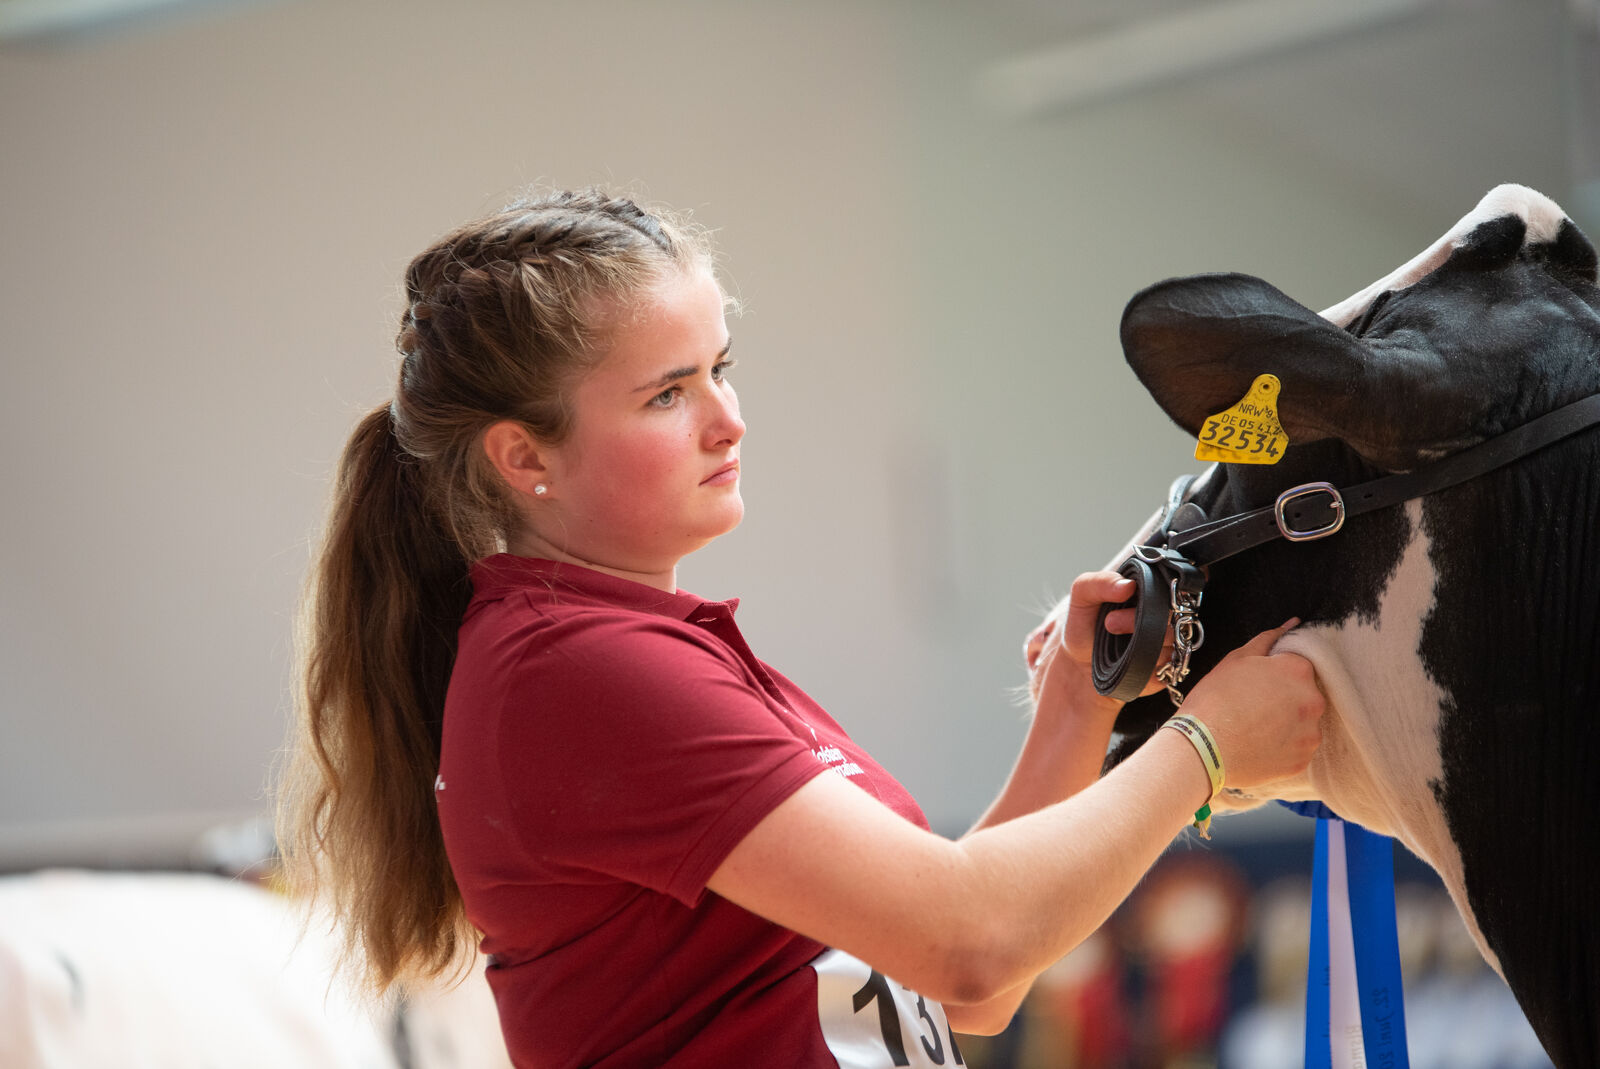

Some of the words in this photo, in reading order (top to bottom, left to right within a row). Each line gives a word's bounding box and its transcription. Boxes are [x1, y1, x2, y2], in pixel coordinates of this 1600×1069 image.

[1239, 403, 1264, 417] NRW
[1221, 413, 1239, 426] DE
[1202, 420, 1279, 458] 32534
